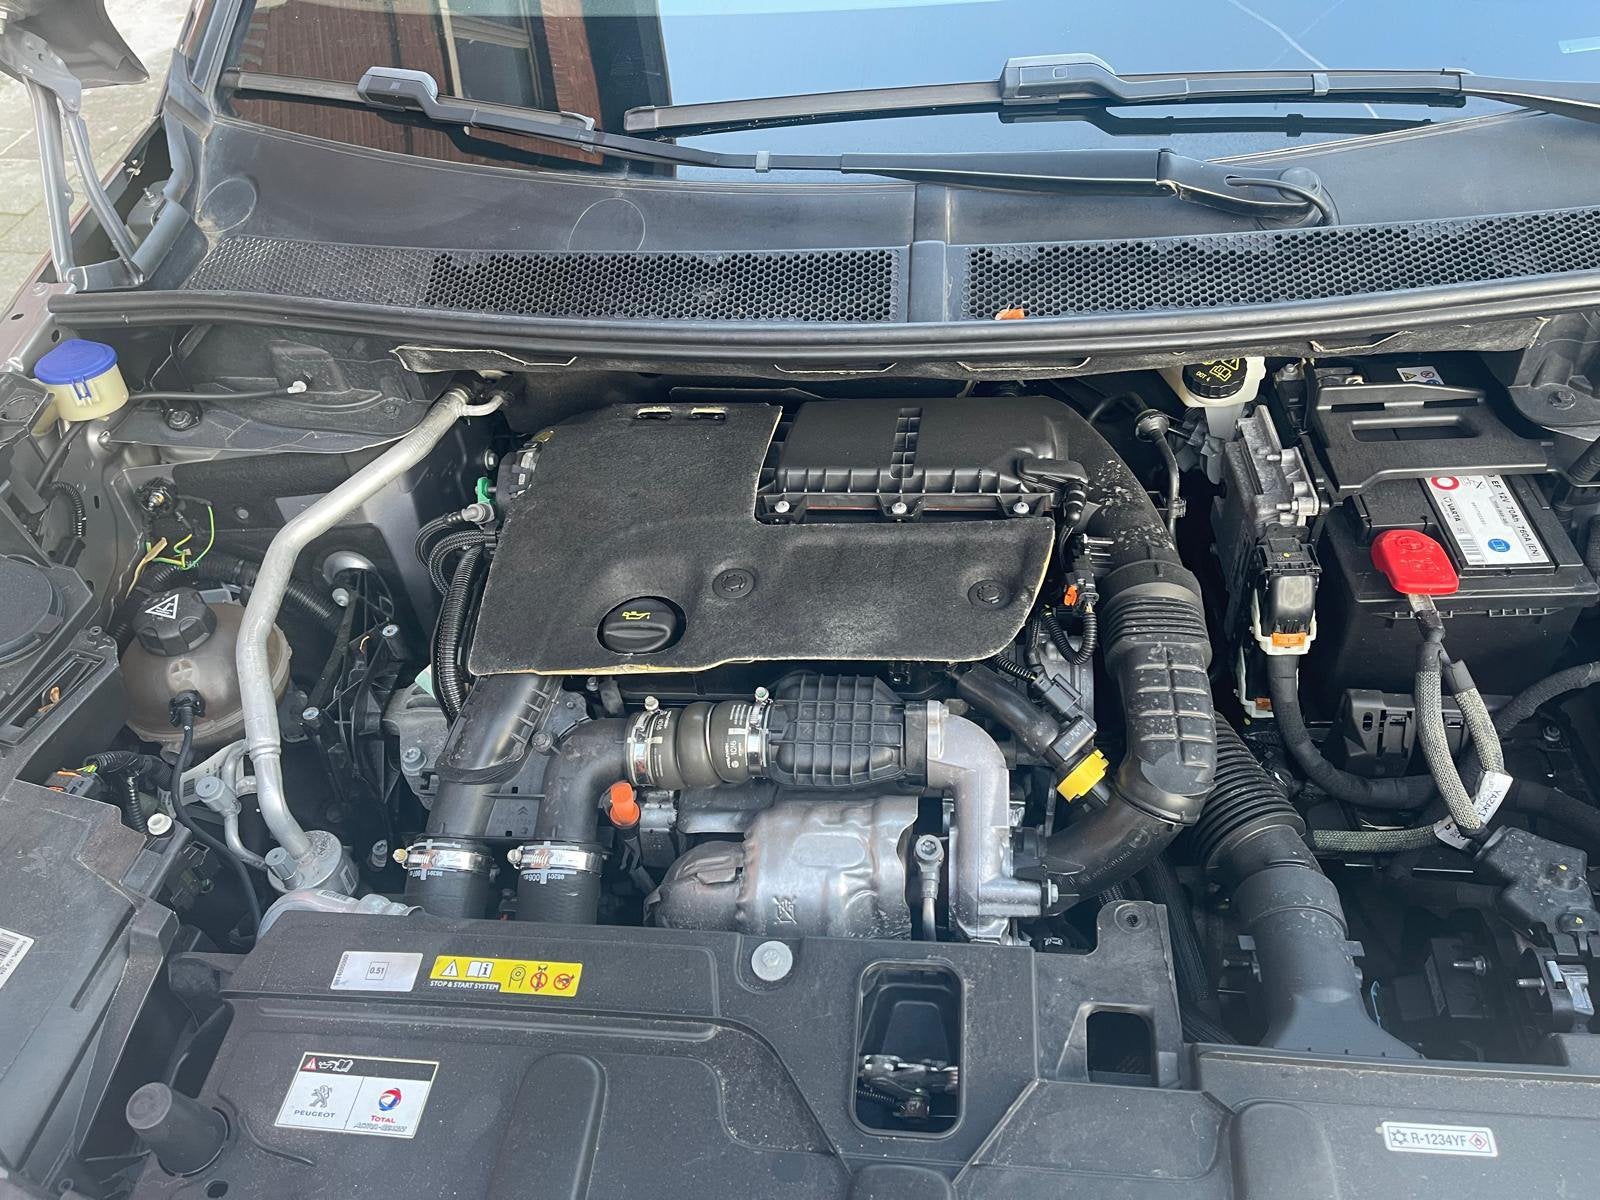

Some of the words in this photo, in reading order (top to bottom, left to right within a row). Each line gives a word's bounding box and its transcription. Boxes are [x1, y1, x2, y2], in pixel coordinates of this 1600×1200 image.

[1195, 370, 1207, 379] DOT
[1447, 501, 1461, 522] VARTA
[1499, 492, 1511, 505] 12V
[1506, 506, 1519, 523] 70Ah
[1517, 526, 1532, 543] 760A
[1478, 790, 1502, 817] YAZAKI
[369, 966, 385, 975] 0.51
[453, 981, 474, 989] START
[473, 983, 499, 991] SYSTEM
[294, 1109, 336, 1119] PEUGEOT
[371, 1115, 396, 1124] TOTAL
[1411, 1132, 1466, 1147] R-1234YF
